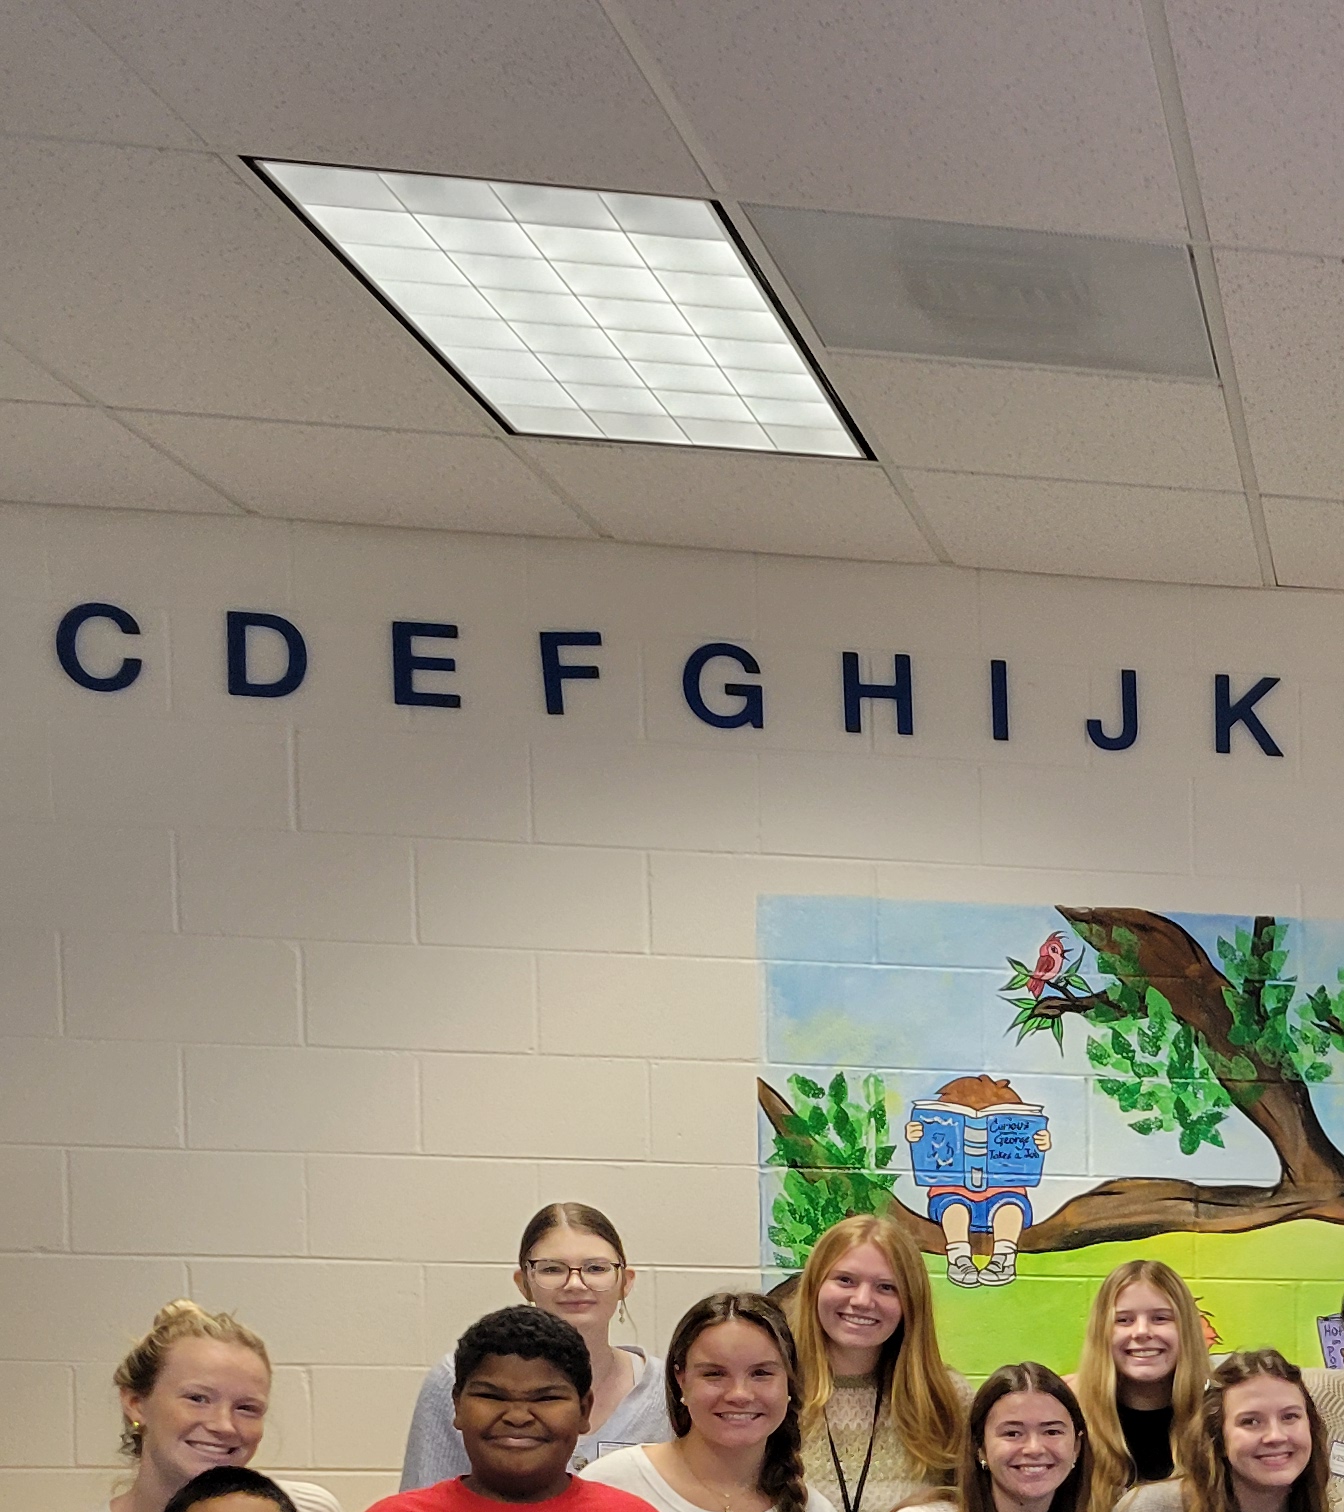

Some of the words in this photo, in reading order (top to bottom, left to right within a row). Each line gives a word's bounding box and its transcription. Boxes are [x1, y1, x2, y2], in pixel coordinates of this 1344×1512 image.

[55, 602, 143, 693] C
[226, 610, 308, 699] D
[391, 620, 462, 709] E
[539, 631, 603, 716] F
[682, 642, 764, 730] G
[842, 651, 914, 736] H
[990, 659, 1009, 742] I
[1086, 669, 1138, 751] J
[1214, 674, 1284, 758] K
